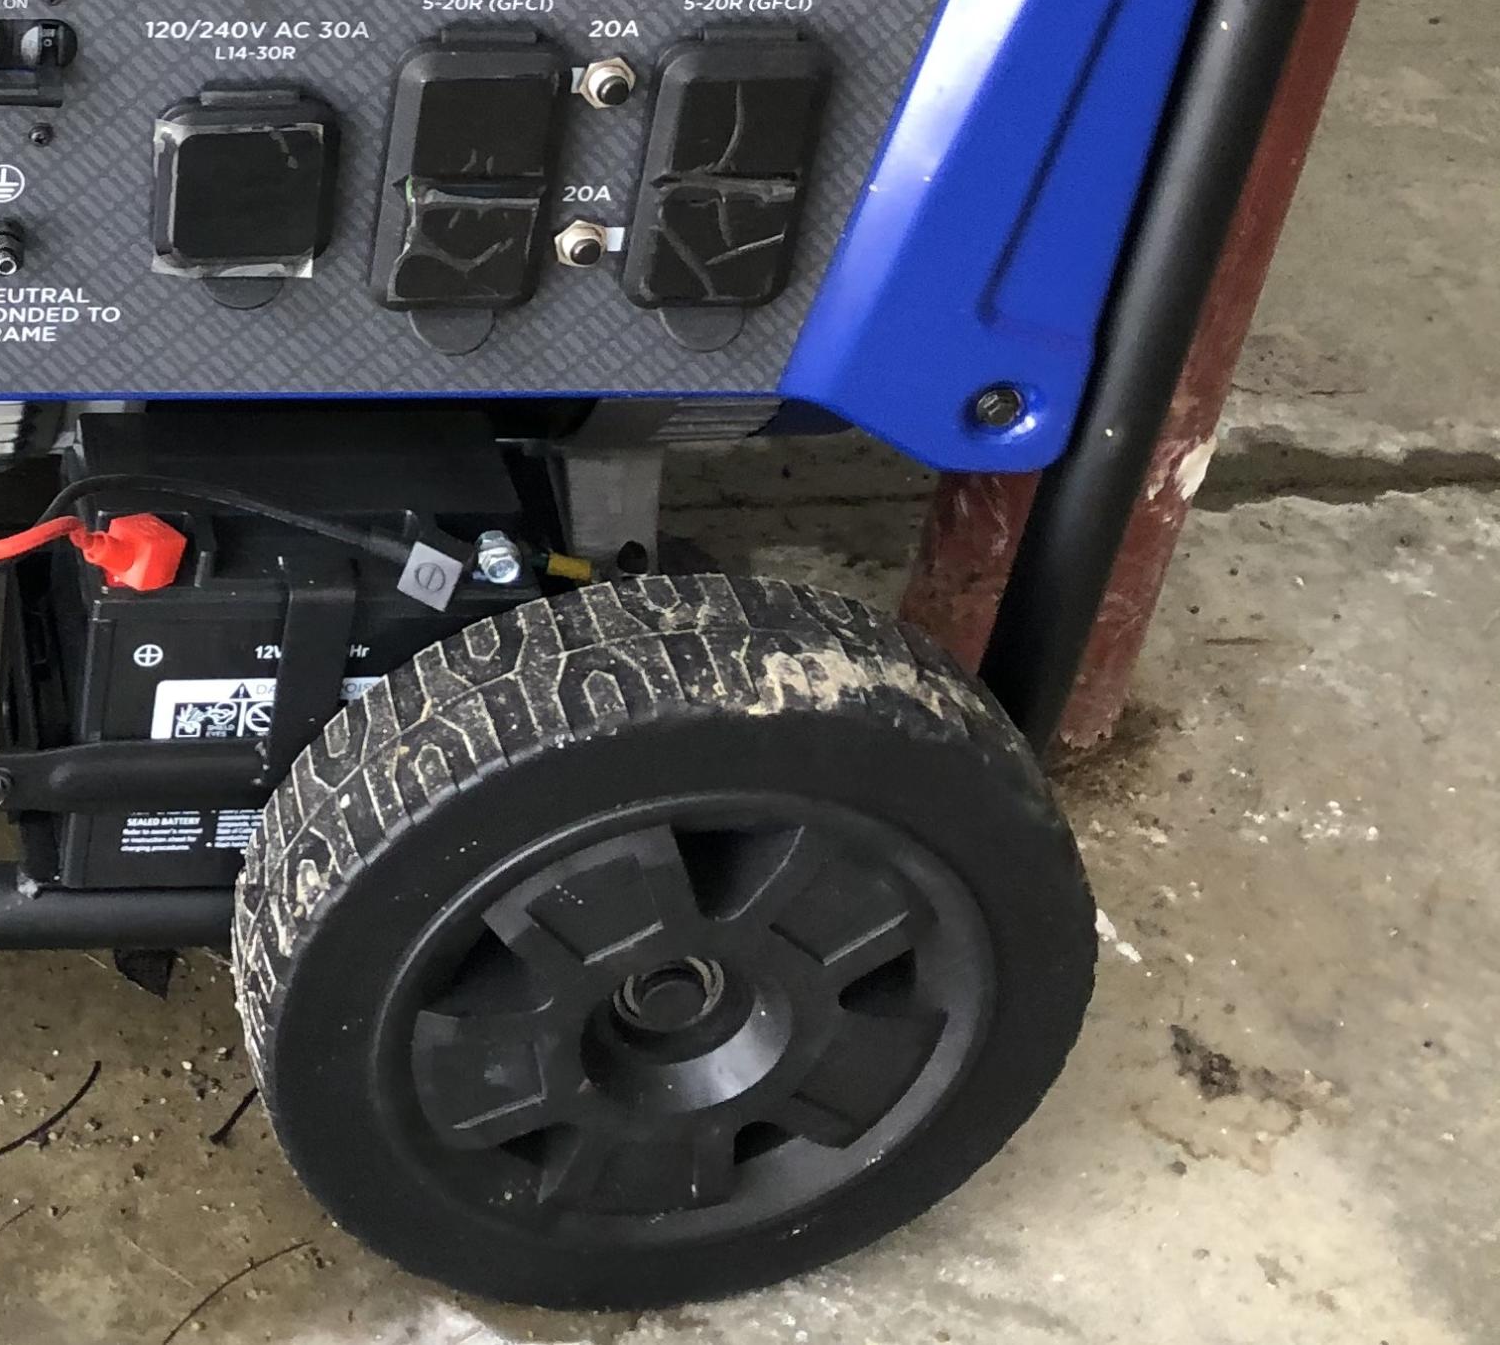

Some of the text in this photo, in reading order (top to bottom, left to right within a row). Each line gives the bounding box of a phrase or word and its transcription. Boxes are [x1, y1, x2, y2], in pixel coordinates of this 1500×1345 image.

[145, 20, 370, 42] 120/240V AC 30A
[588, 19, 640, 38] 20A
[214, 45, 297, 61] L14-30R
[562, 185, 612, 202] 20A
[86, 306, 121, 323] TO
[126, 816, 202, 827] SEALED BATTERY
